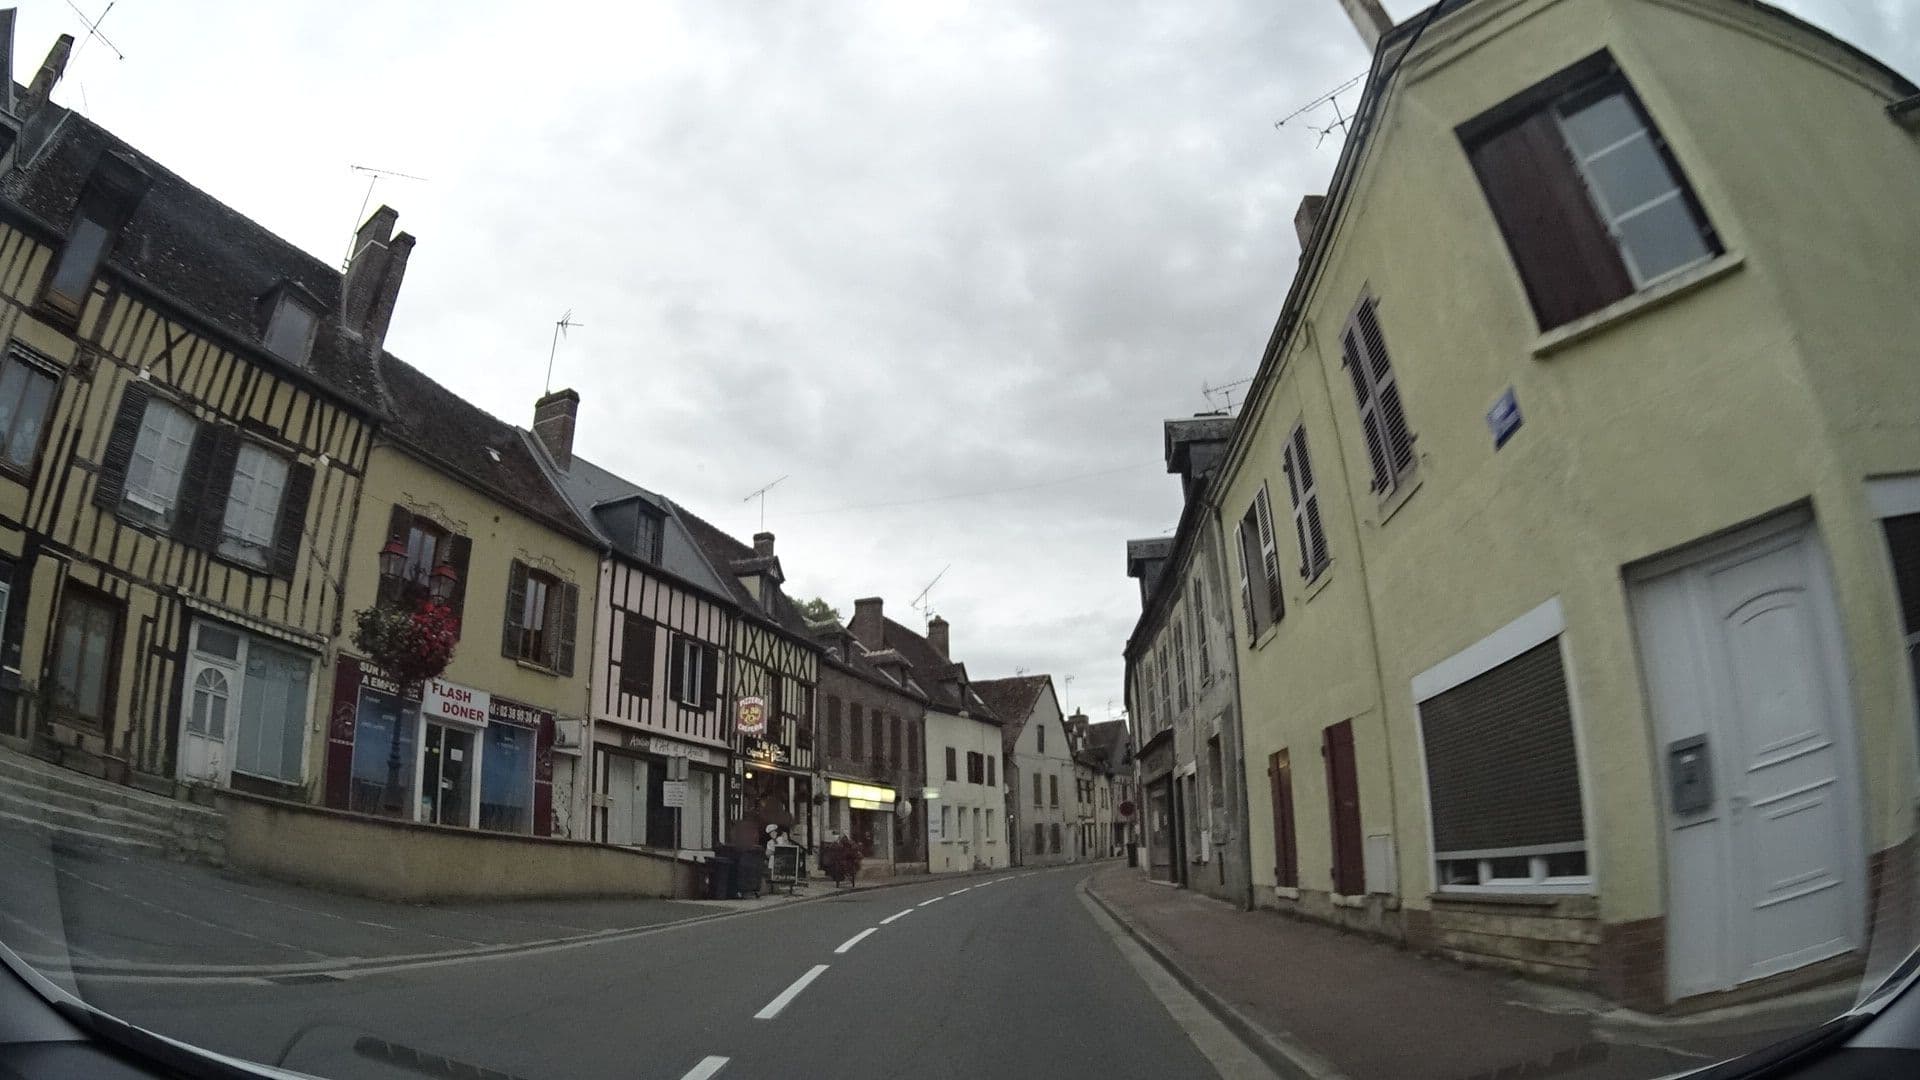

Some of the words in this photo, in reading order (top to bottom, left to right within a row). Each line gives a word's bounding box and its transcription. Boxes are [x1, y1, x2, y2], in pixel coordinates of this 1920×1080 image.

[360, 661, 378, 676] SUR
[362, 675, 369, 685] A
[432, 682, 471, 703] FLASH
[443, 701, 484, 723] DONER
